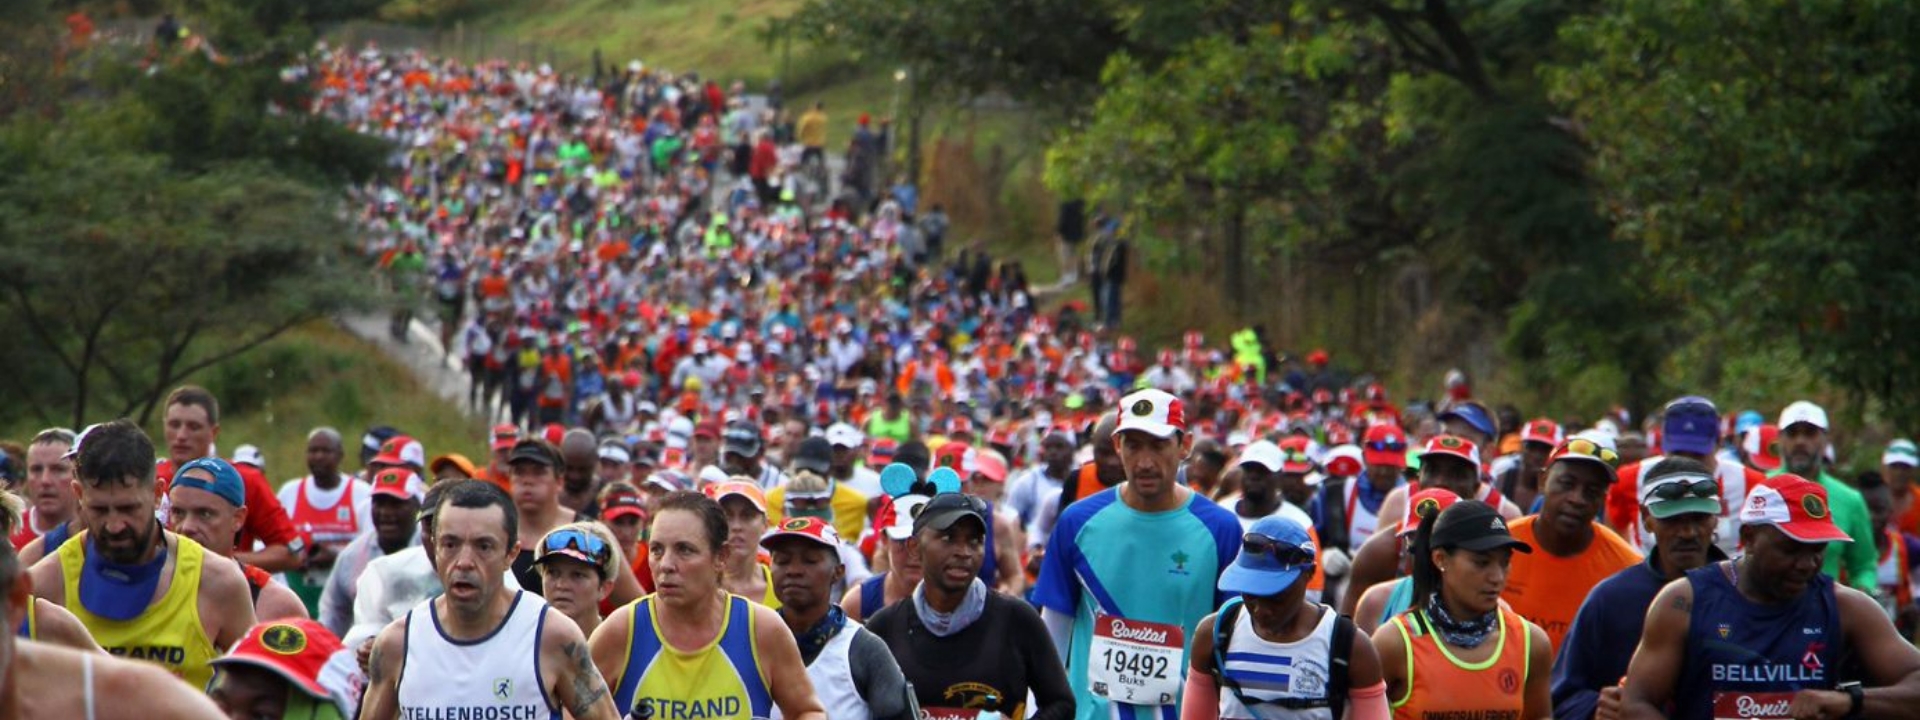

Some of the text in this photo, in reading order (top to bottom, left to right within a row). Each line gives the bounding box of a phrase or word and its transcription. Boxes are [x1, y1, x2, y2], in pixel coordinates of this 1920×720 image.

[1111, 619, 1168, 643] Bonitas
[1103, 648, 1168, 679] 19492
[1712, 664, 1824, 681] BELLVILLE
[1119, 674, 1145, 686] Buks
[1126, 690, 1134, 700] 2
[1736, 695, 1789, 717] Bonit
